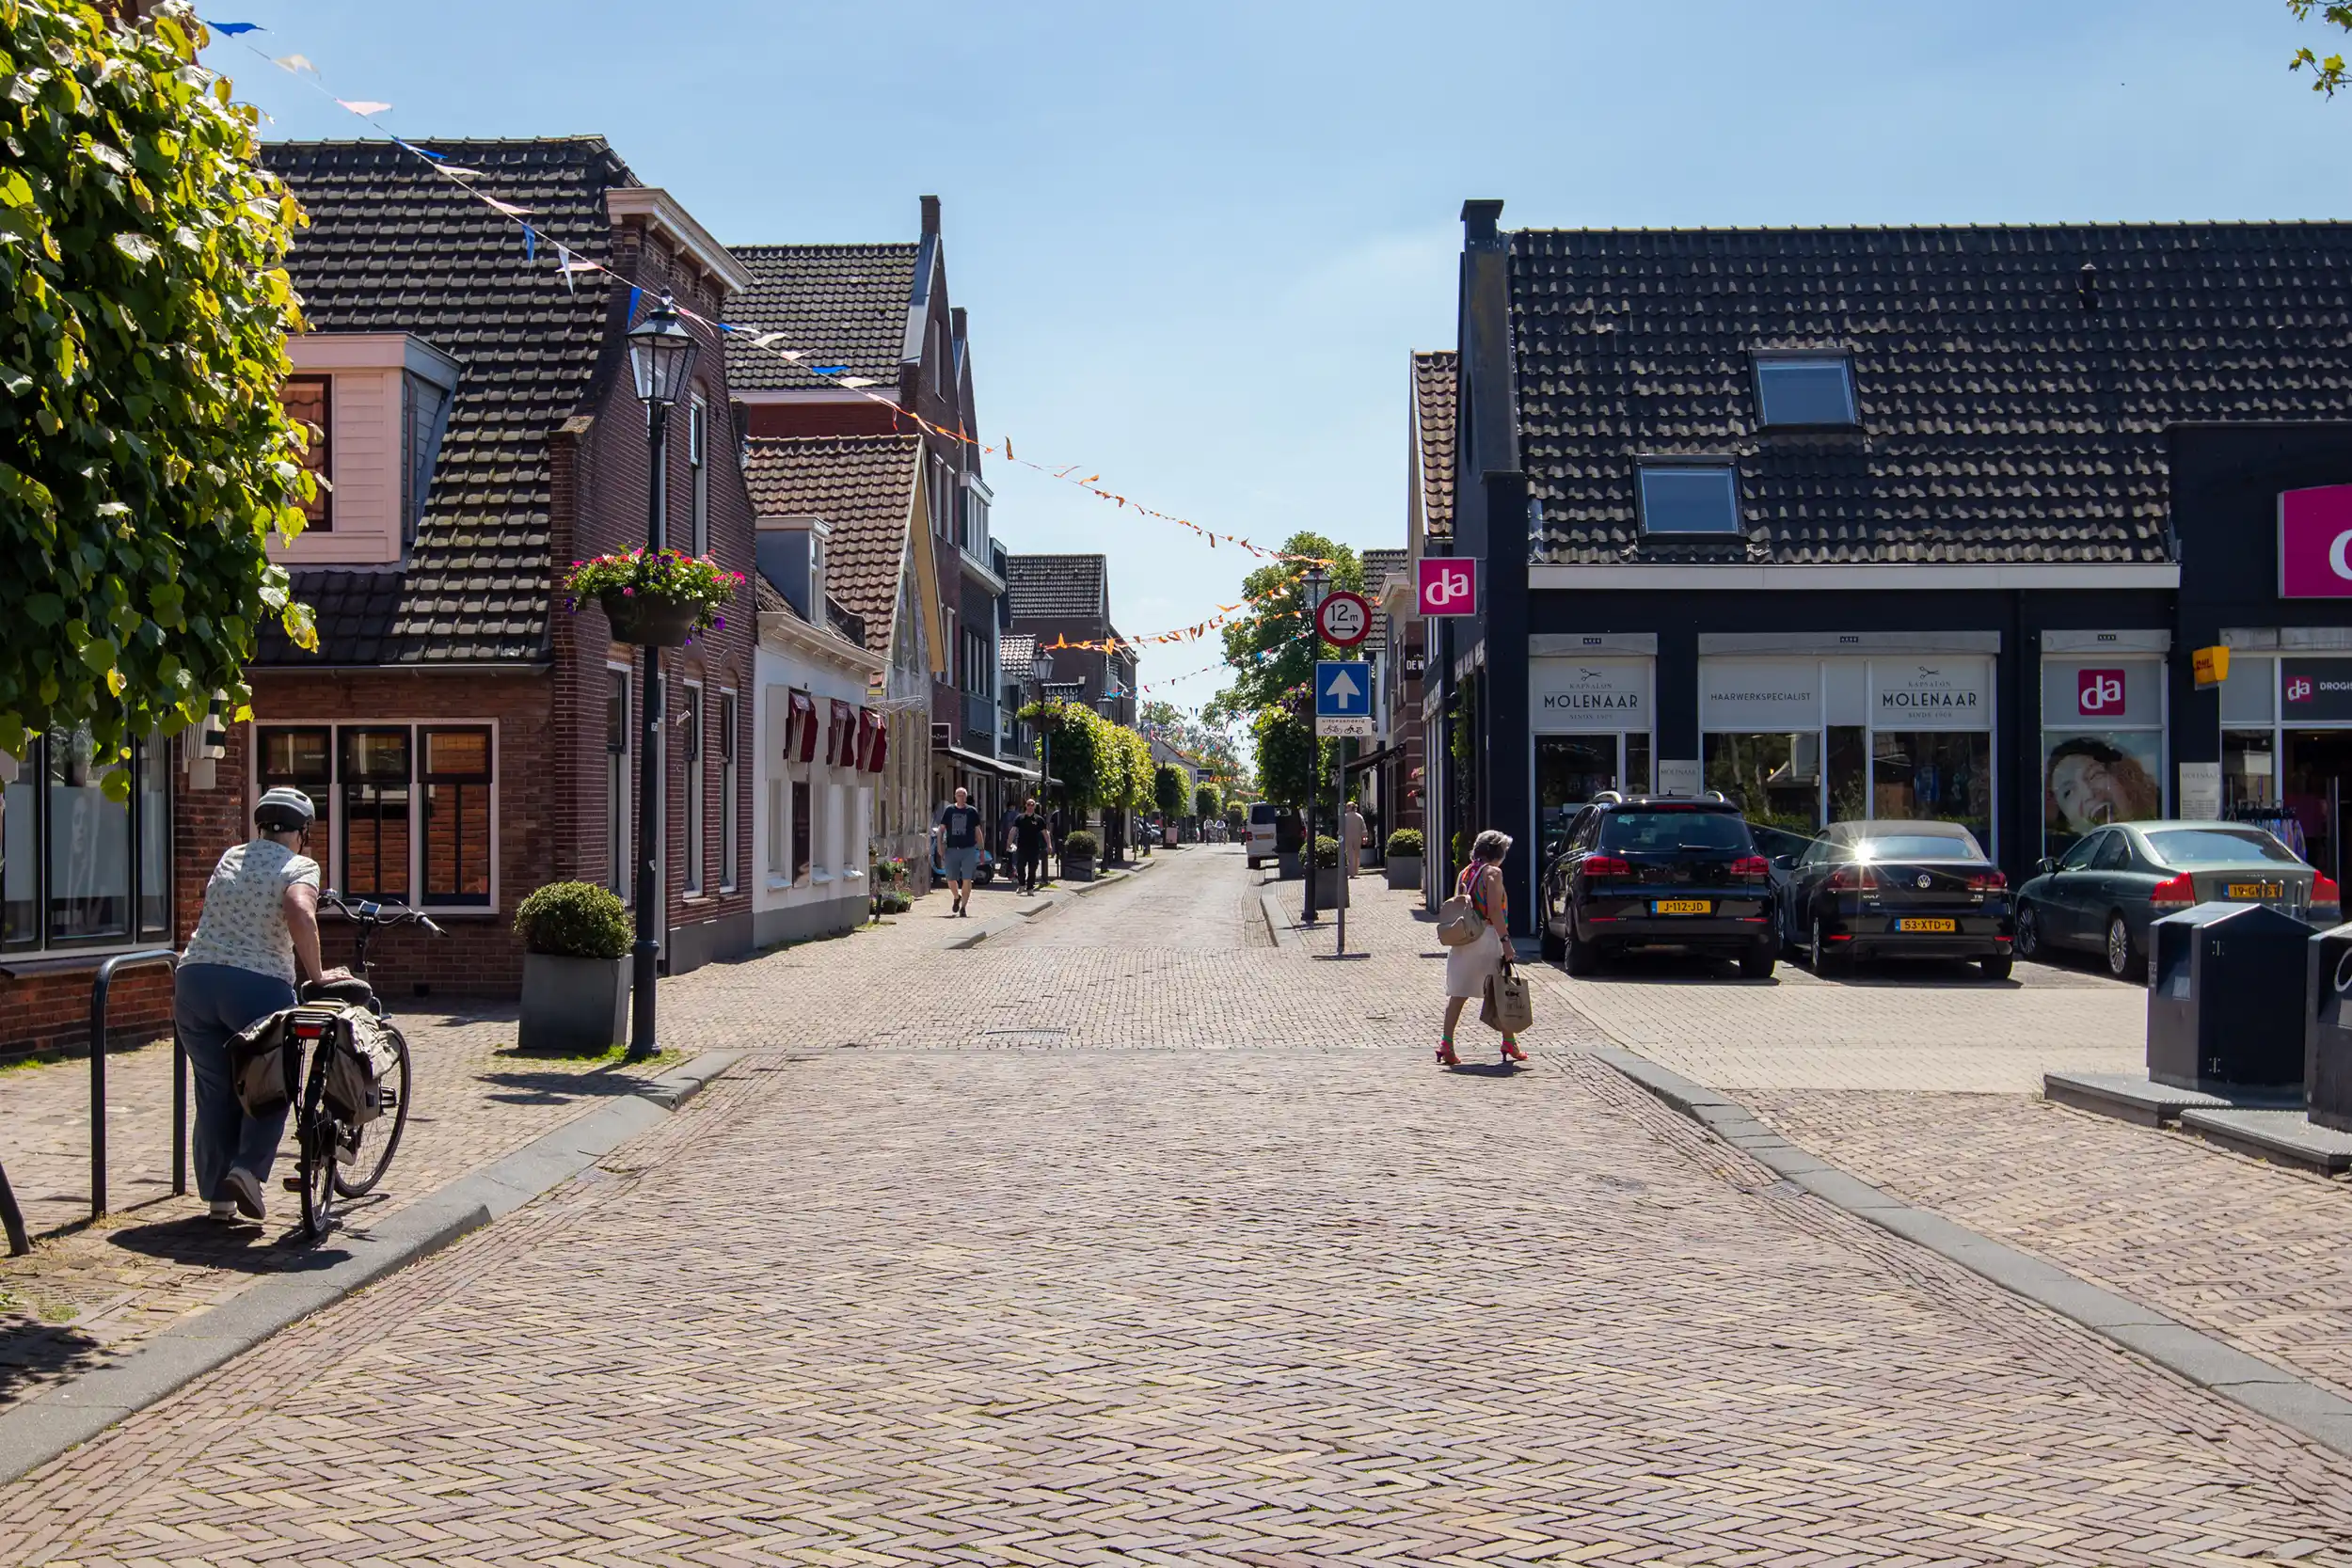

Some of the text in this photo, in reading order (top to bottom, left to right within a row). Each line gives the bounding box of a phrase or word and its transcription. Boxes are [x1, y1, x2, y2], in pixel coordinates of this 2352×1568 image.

[1425, 568, 1469, 605] da
[1406, 659, 1417, 670] DE
[1709, 692, 1811, 701] HAARWERKSPECIALIST
[2081, 675, 2122, 709] da
[2287, 679, 2311, 701] da
[1544, 694, 1638, 708] MOLENAAR
[1883, 692, 1977, 706] MOLENAAR
[1664, 902, 1704, 911] J-112-JD
[1904, 920, 1951, 929] 53-XTD-9
